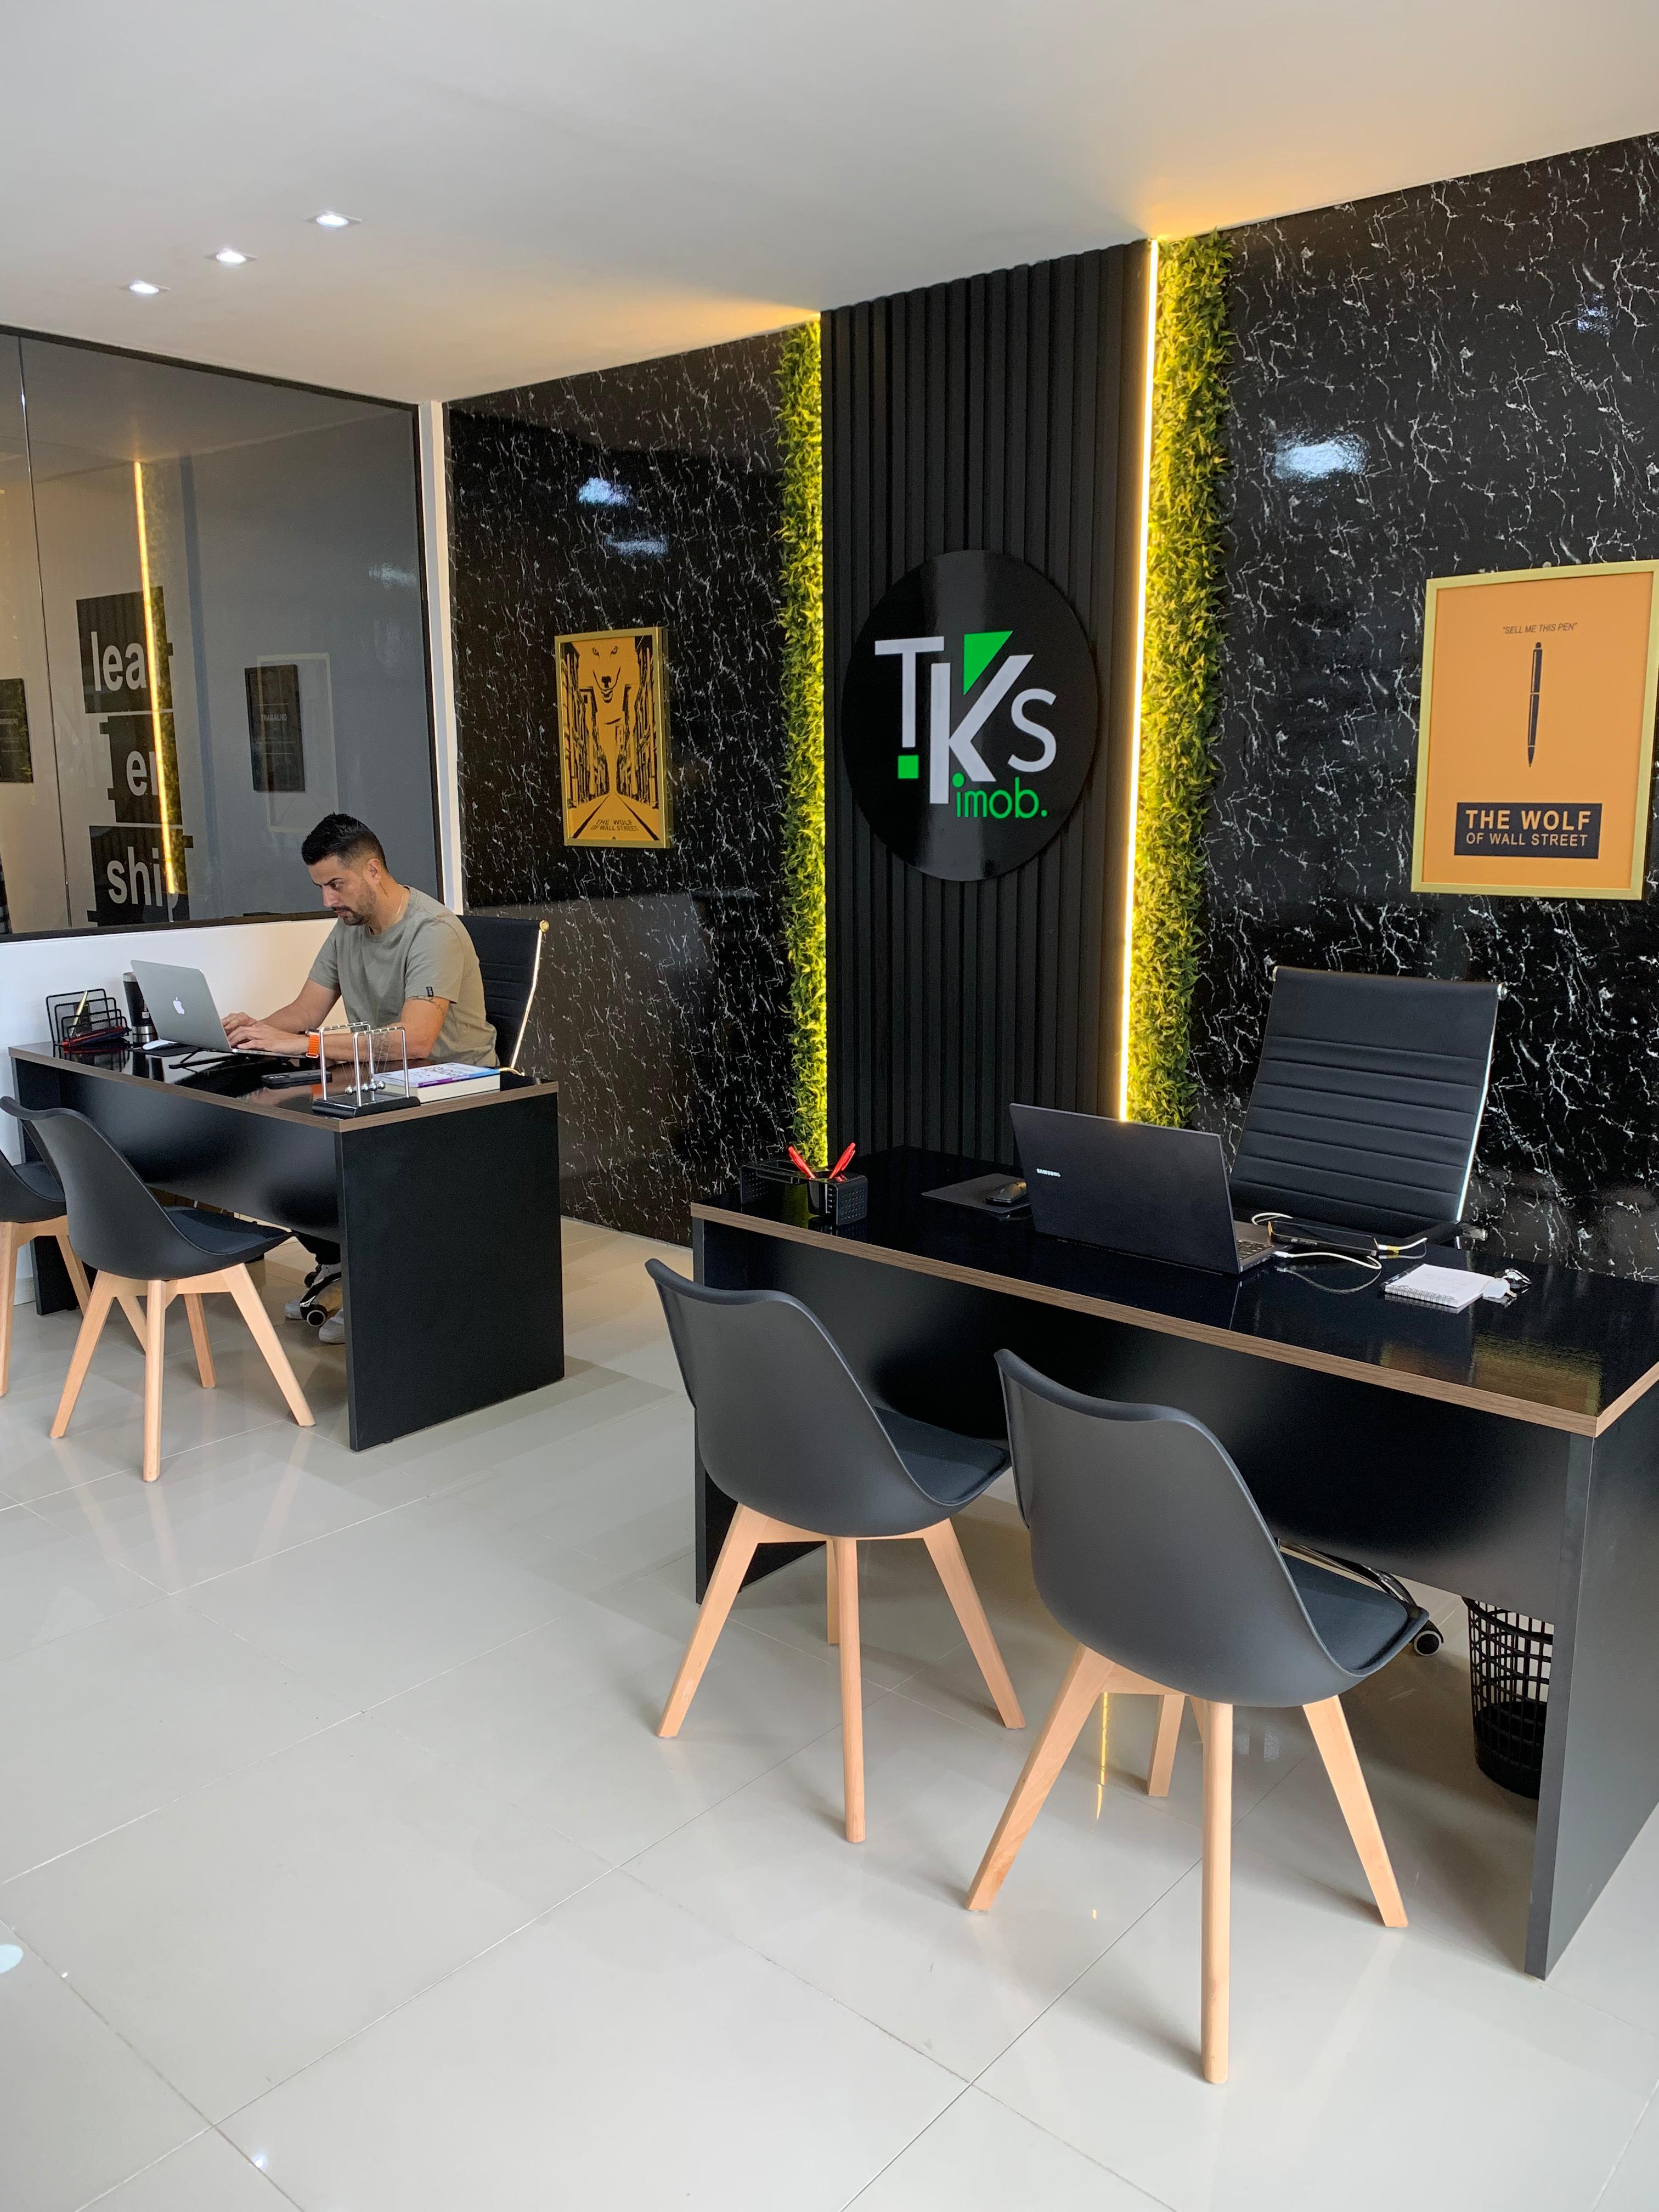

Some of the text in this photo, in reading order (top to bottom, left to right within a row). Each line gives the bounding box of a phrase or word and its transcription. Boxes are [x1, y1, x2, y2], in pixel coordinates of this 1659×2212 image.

[1539, 624, 1556, 632] THIS
[91, 624, 161, 691] lea
[952, 772, 1047, 819] imob.
[1465, 810, 1591, 831] THE WOLF
[1466, 832, 1588, 847] OF WALL STREET
[1036, 1168, 1061, 1177] SAMSUNG
